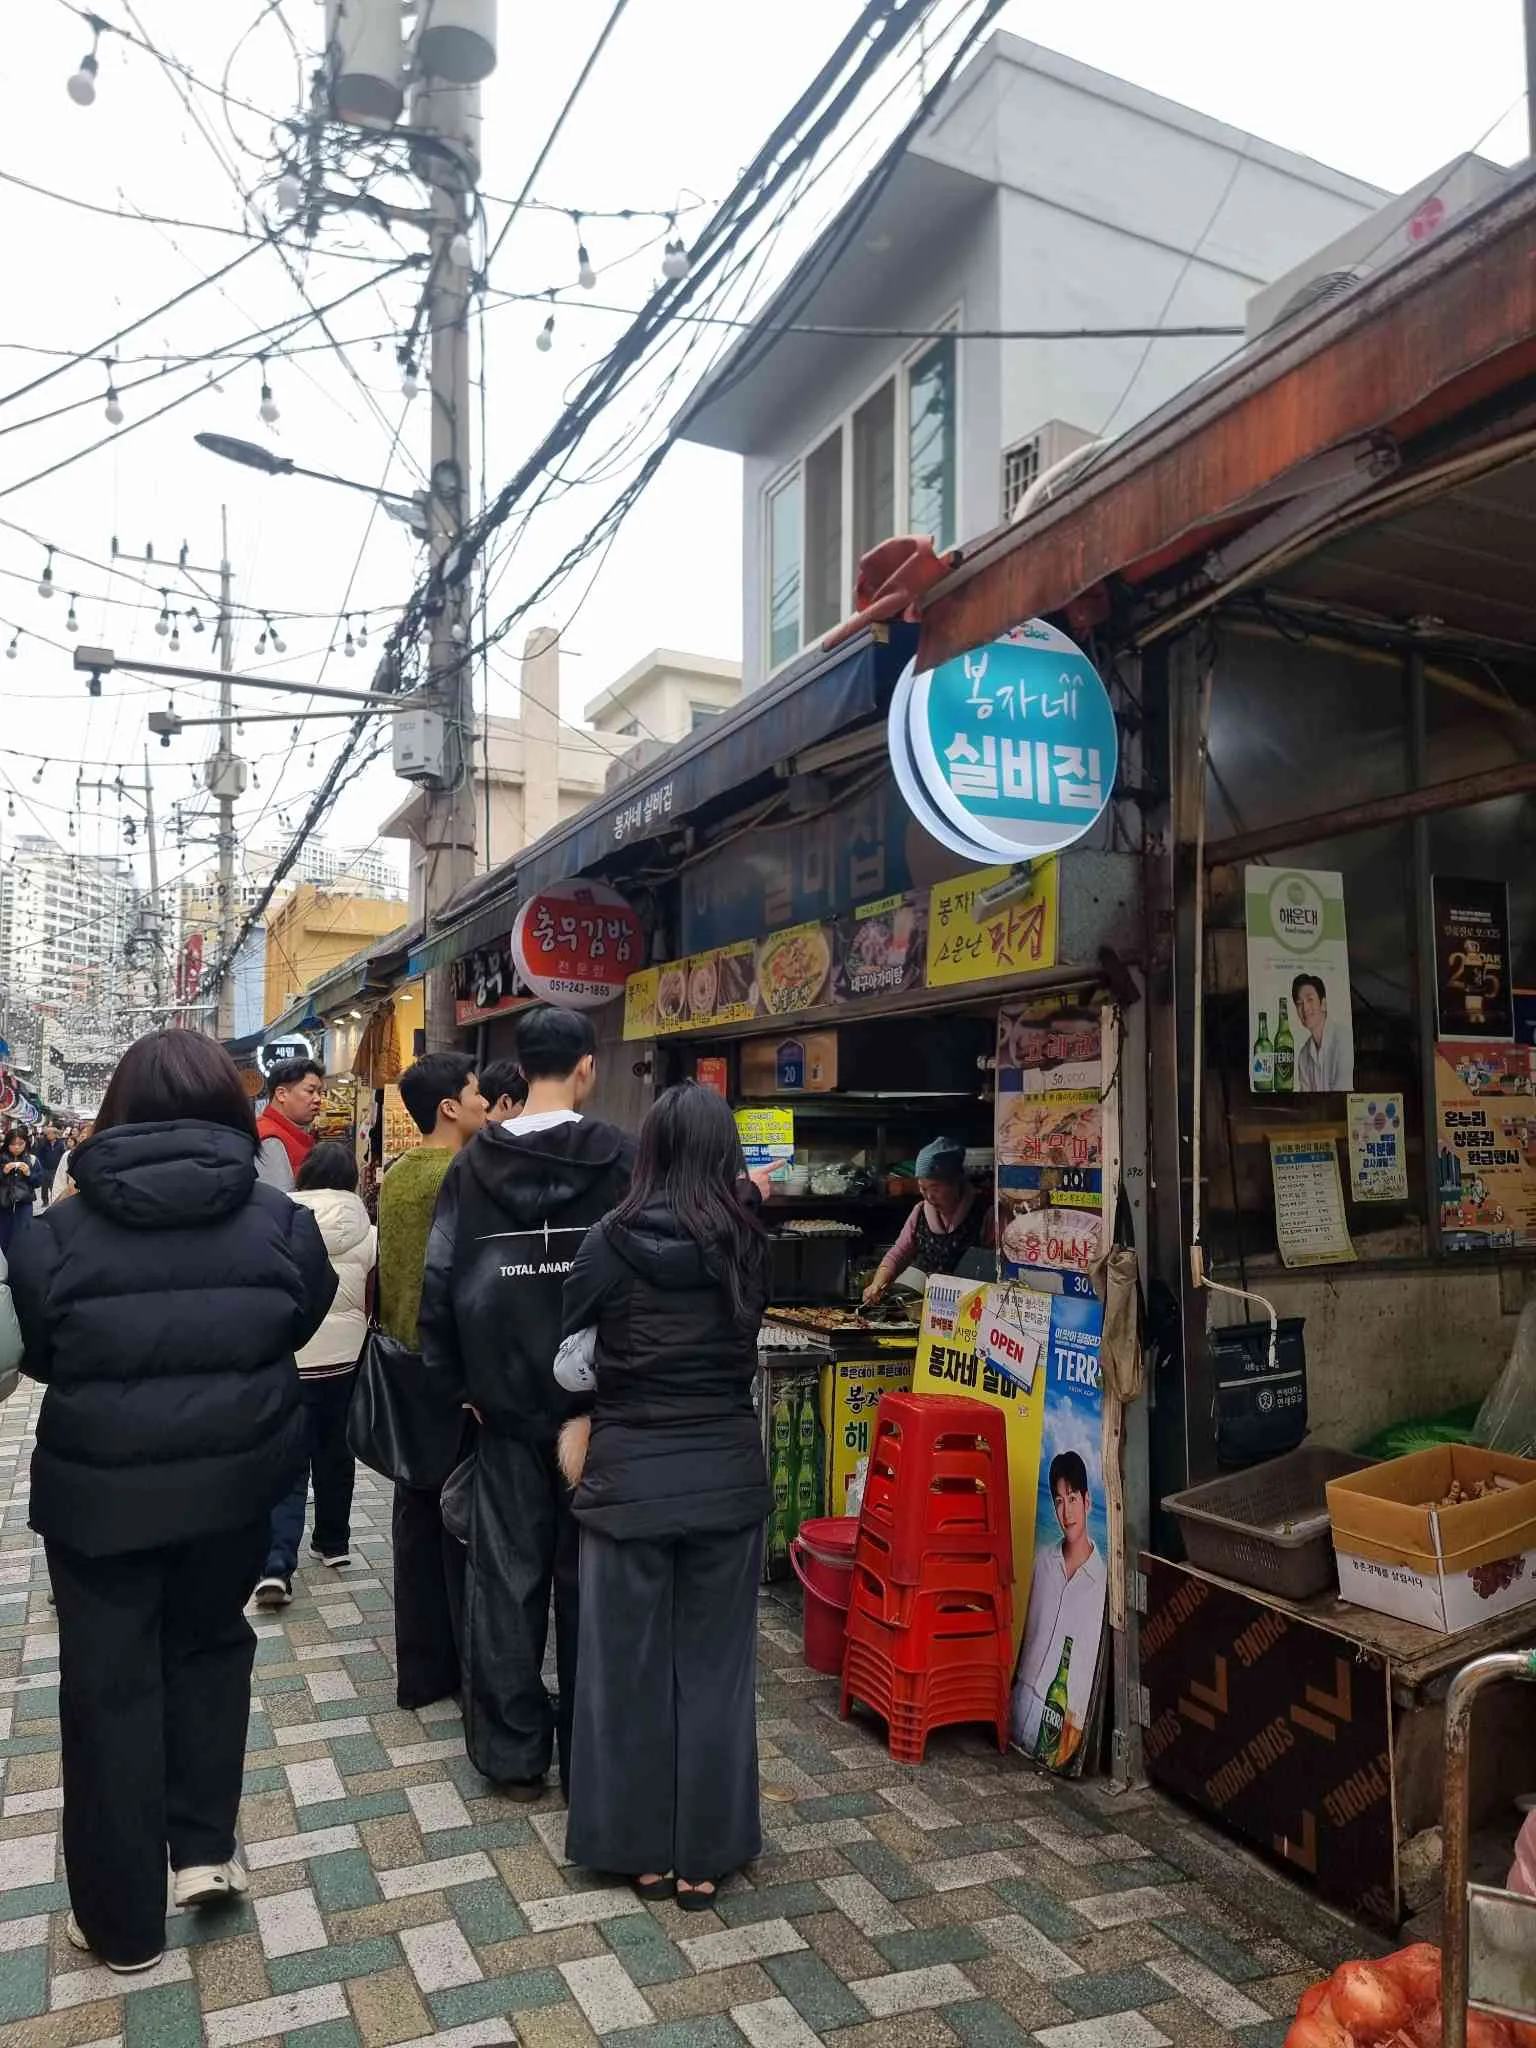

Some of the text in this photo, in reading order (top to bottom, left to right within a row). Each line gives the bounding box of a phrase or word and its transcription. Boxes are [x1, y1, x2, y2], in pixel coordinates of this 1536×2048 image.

[963, 652, 1078, 721] 봉자네
[943, 732, 1102, 810] 실비집
[613, 781, 673, 840] 봉자네 실비집
[532, 905, 634, 962] 충무김밥
[933, 895, 1048, 968] 소문난 맛집
[1444, 1111, 1487, 1127] 온누리
[1453, 1130, 1495, 1147] 상품권
[1467, 1149, 1520, 1165] 환급행사
[499, 1264, 536, 1277] TOTAL
[928, 1344, 979, 1388] 봉자네
[988, 1328, 1024, 1364] OPEN
[1232, 1608, 1288, 1668] PHONG
[1042, 1706, 1064, 1730] TERRA
[1204, 1716, 1296, 1809] SONG PHONG
[1322, 1759, 1387, 1828] PHONG
